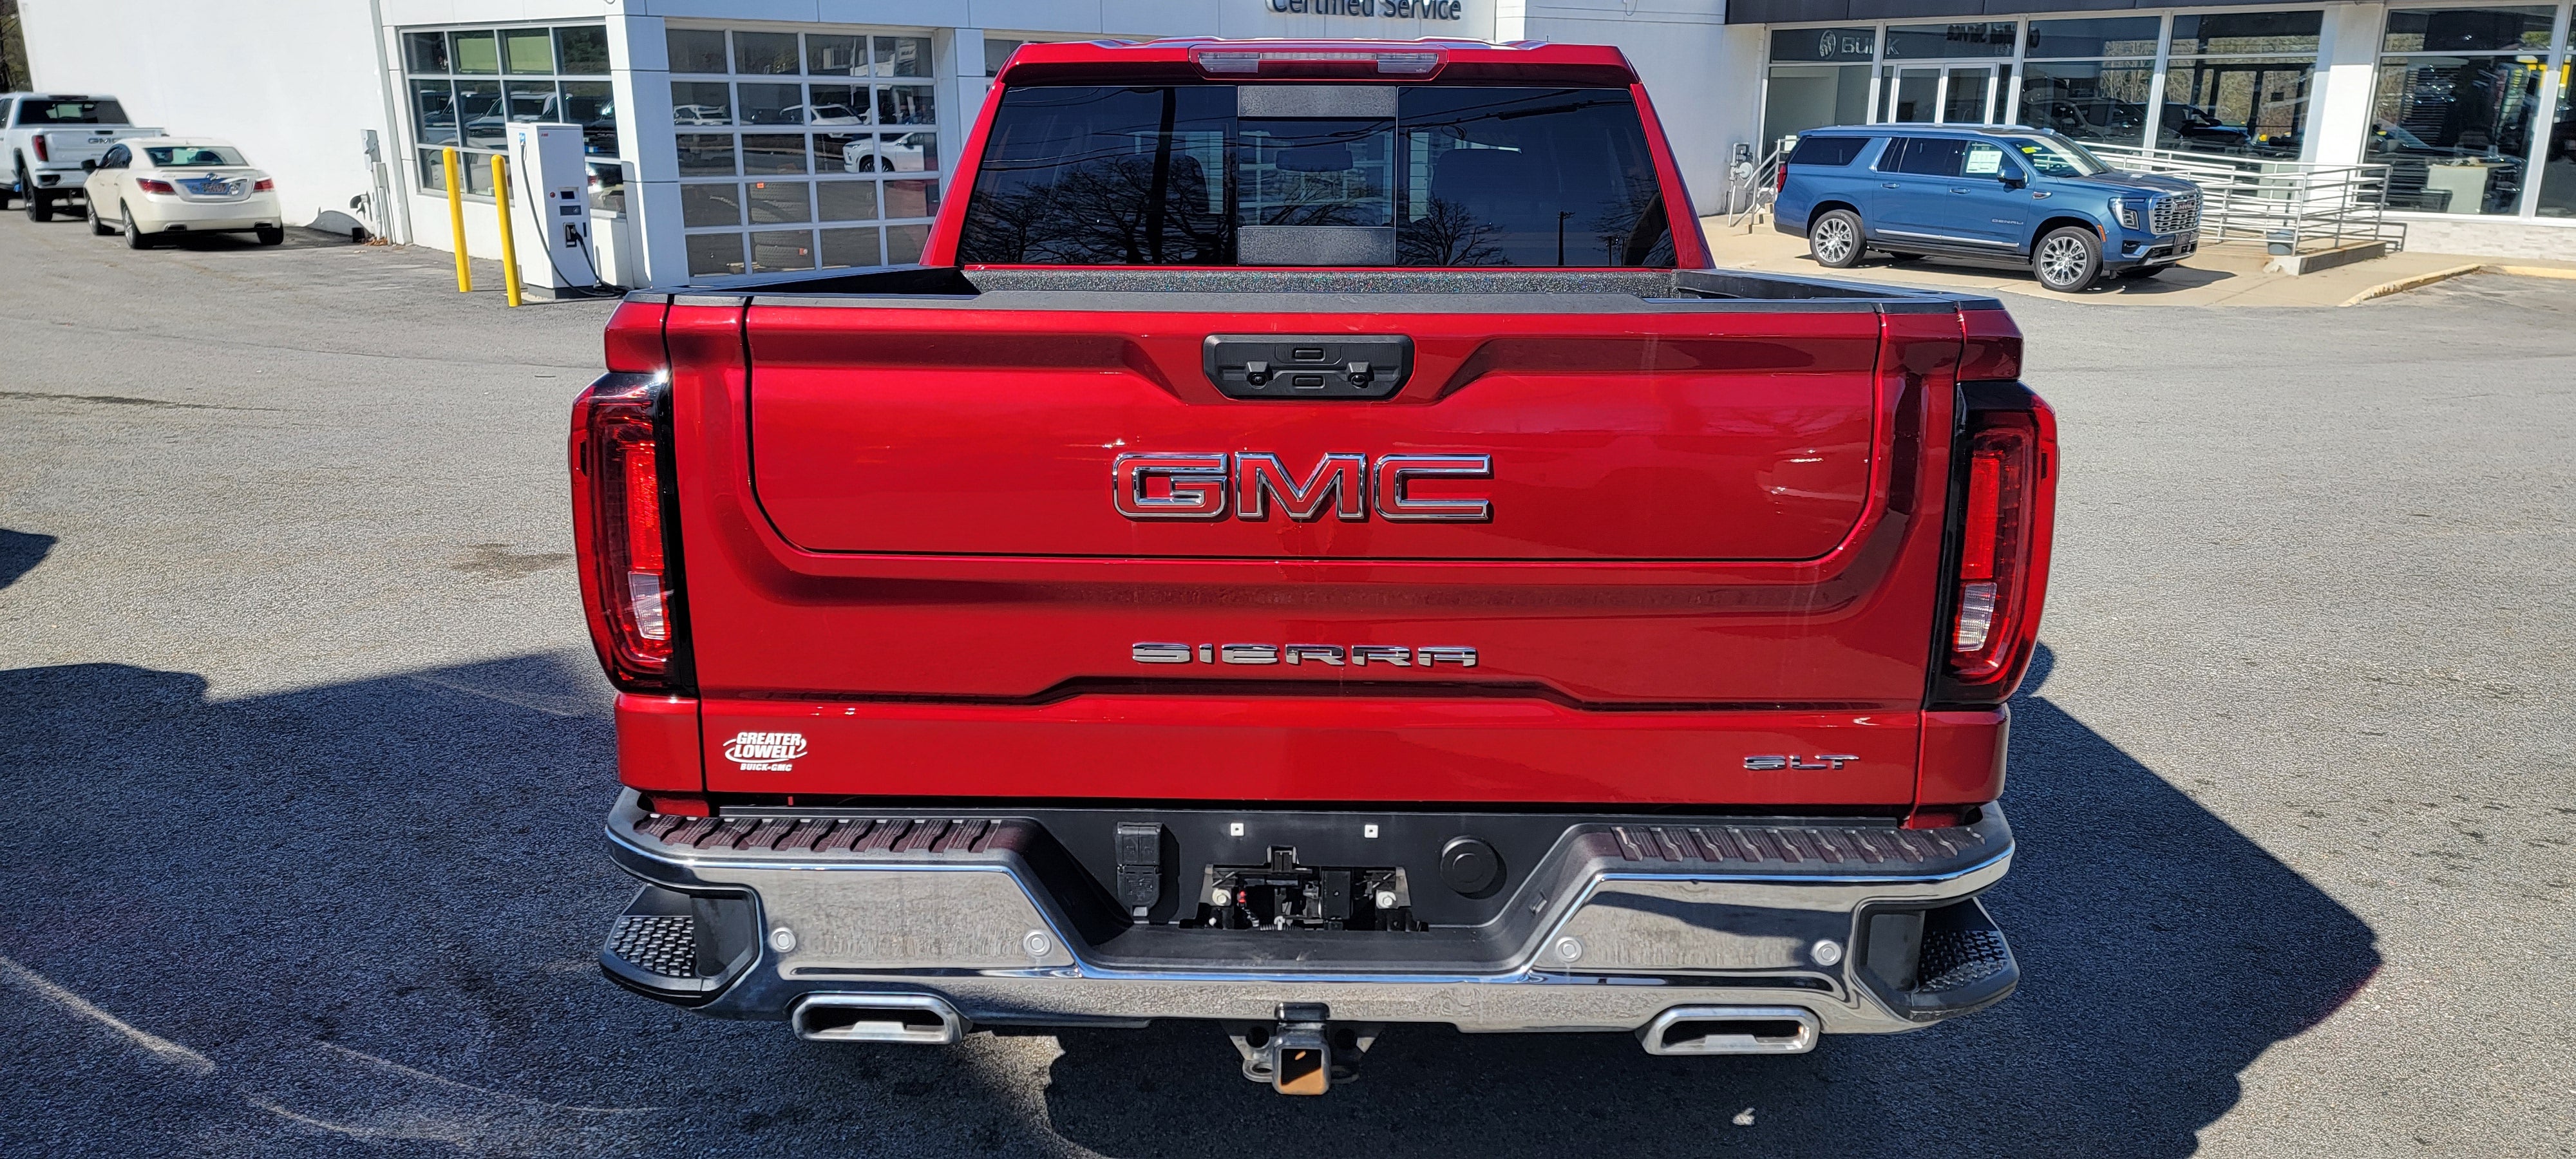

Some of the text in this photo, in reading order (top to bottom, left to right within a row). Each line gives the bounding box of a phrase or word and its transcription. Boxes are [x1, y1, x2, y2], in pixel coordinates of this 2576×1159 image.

[1379, 0, 1462, 19] Service
[1841, 37, 1900, 55] BUIK
[1113, 451, 1492, 521] GMC
[1132, 641, 1478, 666] SIERRA
[736, 732, 802, 746] GREATER
[734, 744, 796, 759] LOWELL
[1743, 754, 1860, 770] SLT
